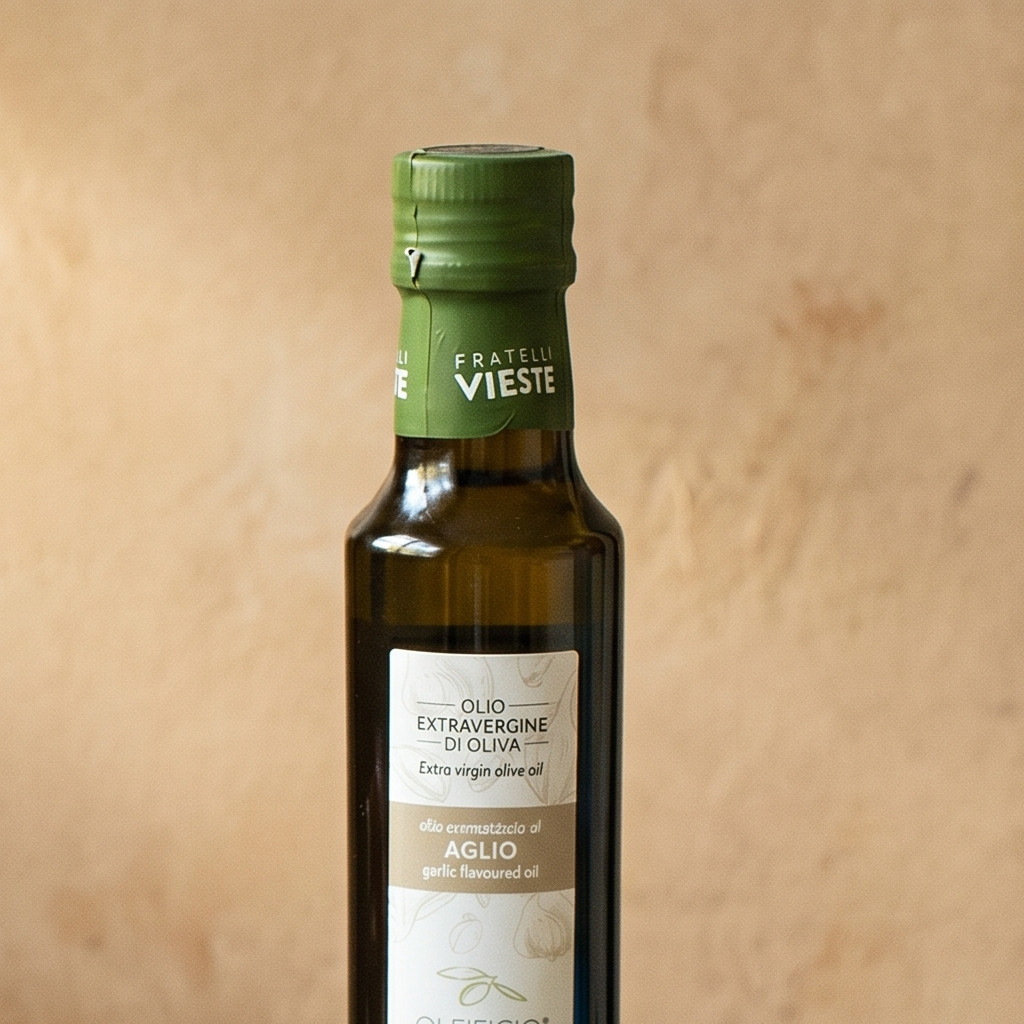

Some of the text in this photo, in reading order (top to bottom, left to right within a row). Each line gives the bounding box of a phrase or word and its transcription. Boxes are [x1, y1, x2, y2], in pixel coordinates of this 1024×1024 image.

[454, 346, 552, 370] FRATELLI
[453, 365, 556, 402] VIESTE
[461, 698, 506, 714] OLIO
[417, 716, 549, 734] EXTRAVERGINE
[445, 736, 521, 753] DI OLIVA
[419, 760, 544, 781] Extra virgin olive oil
[443, 840, 518, 860] AGLIO
[422, 863, 539, 881] garlic flavoured oil
